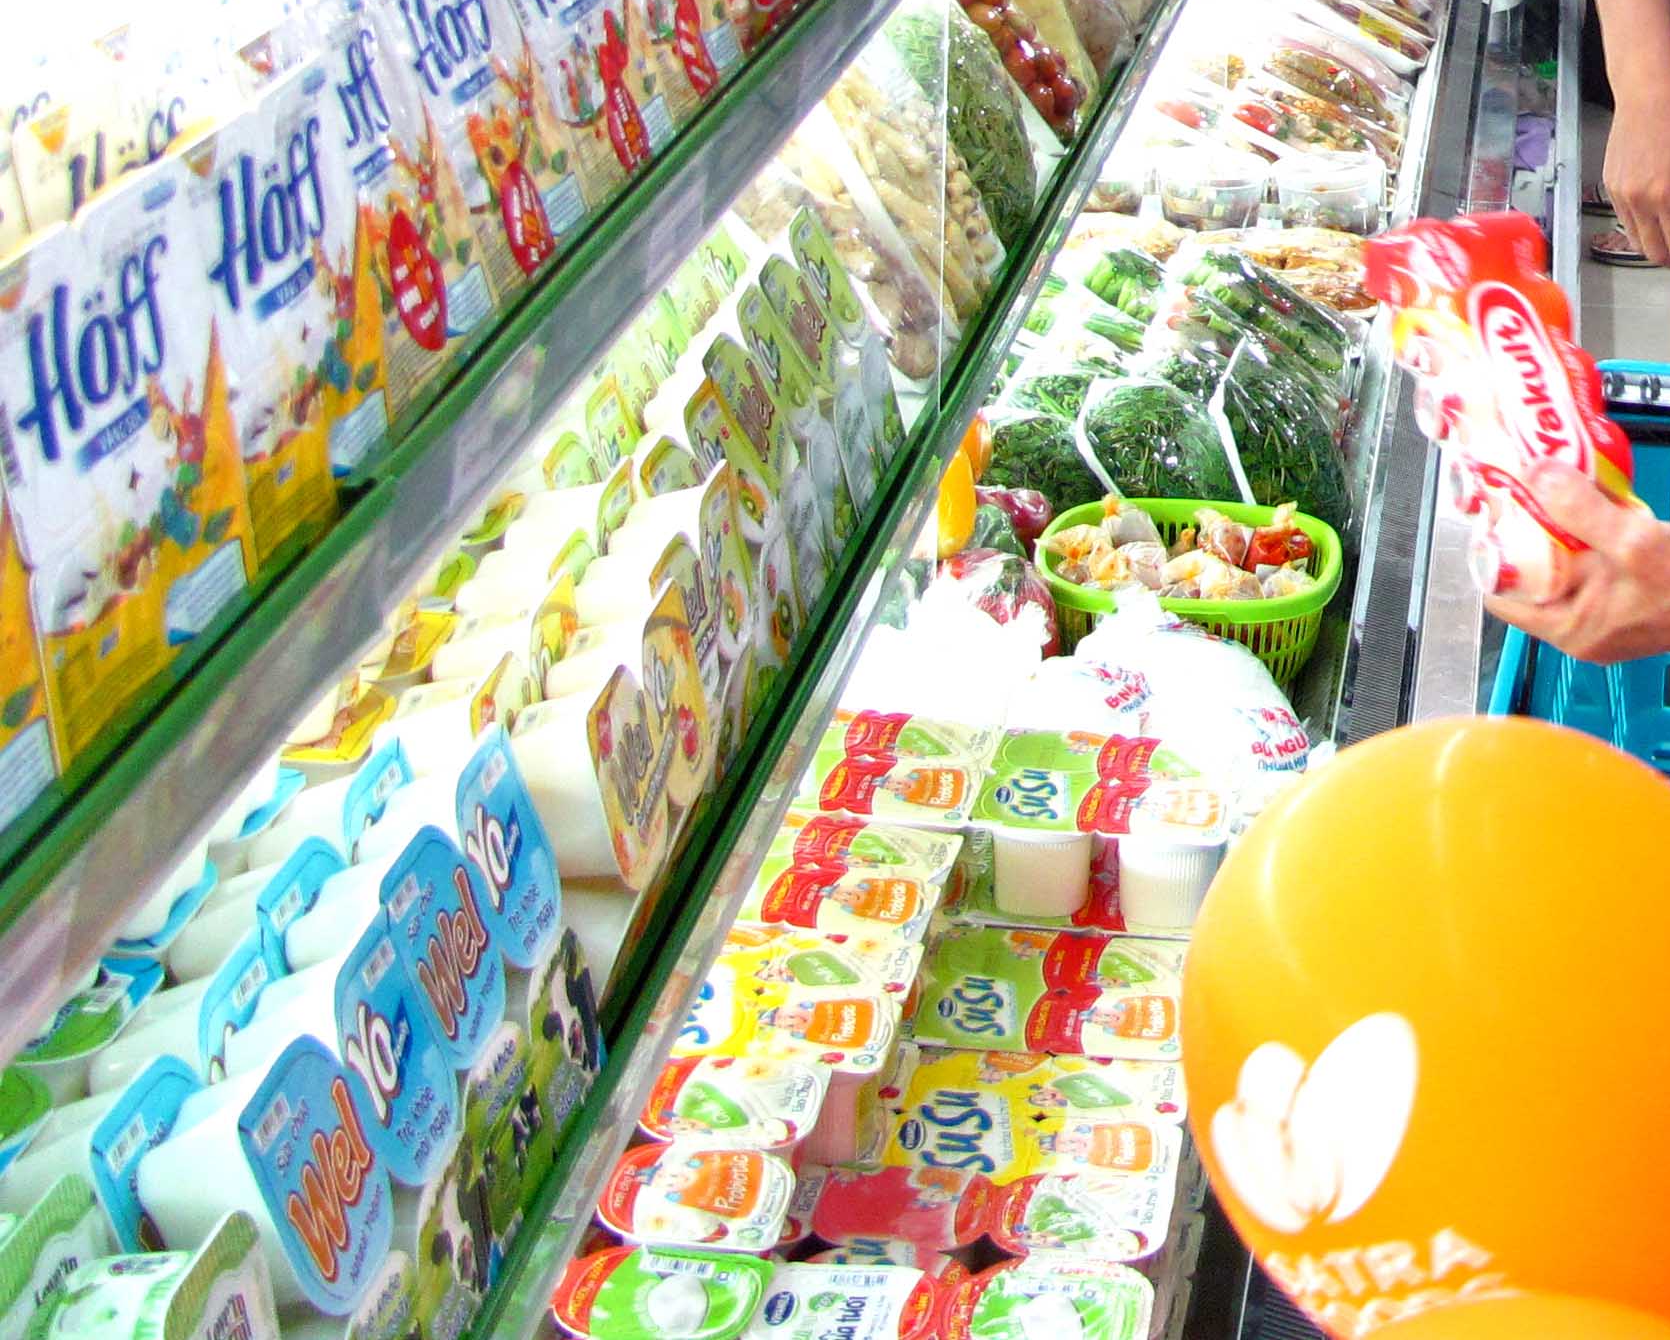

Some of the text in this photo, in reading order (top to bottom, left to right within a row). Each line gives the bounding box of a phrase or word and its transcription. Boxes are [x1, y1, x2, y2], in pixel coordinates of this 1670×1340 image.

[209, 116, 325, 311] Höff
[18, 234, 168, 461] Höff
[1496, 313, 1571, 458] Yakult
[416, 864, 488, 1041] Wel
[286, 1074, 374, 1283] Wel
[714, 1151, 750, 1211] Probiotic
